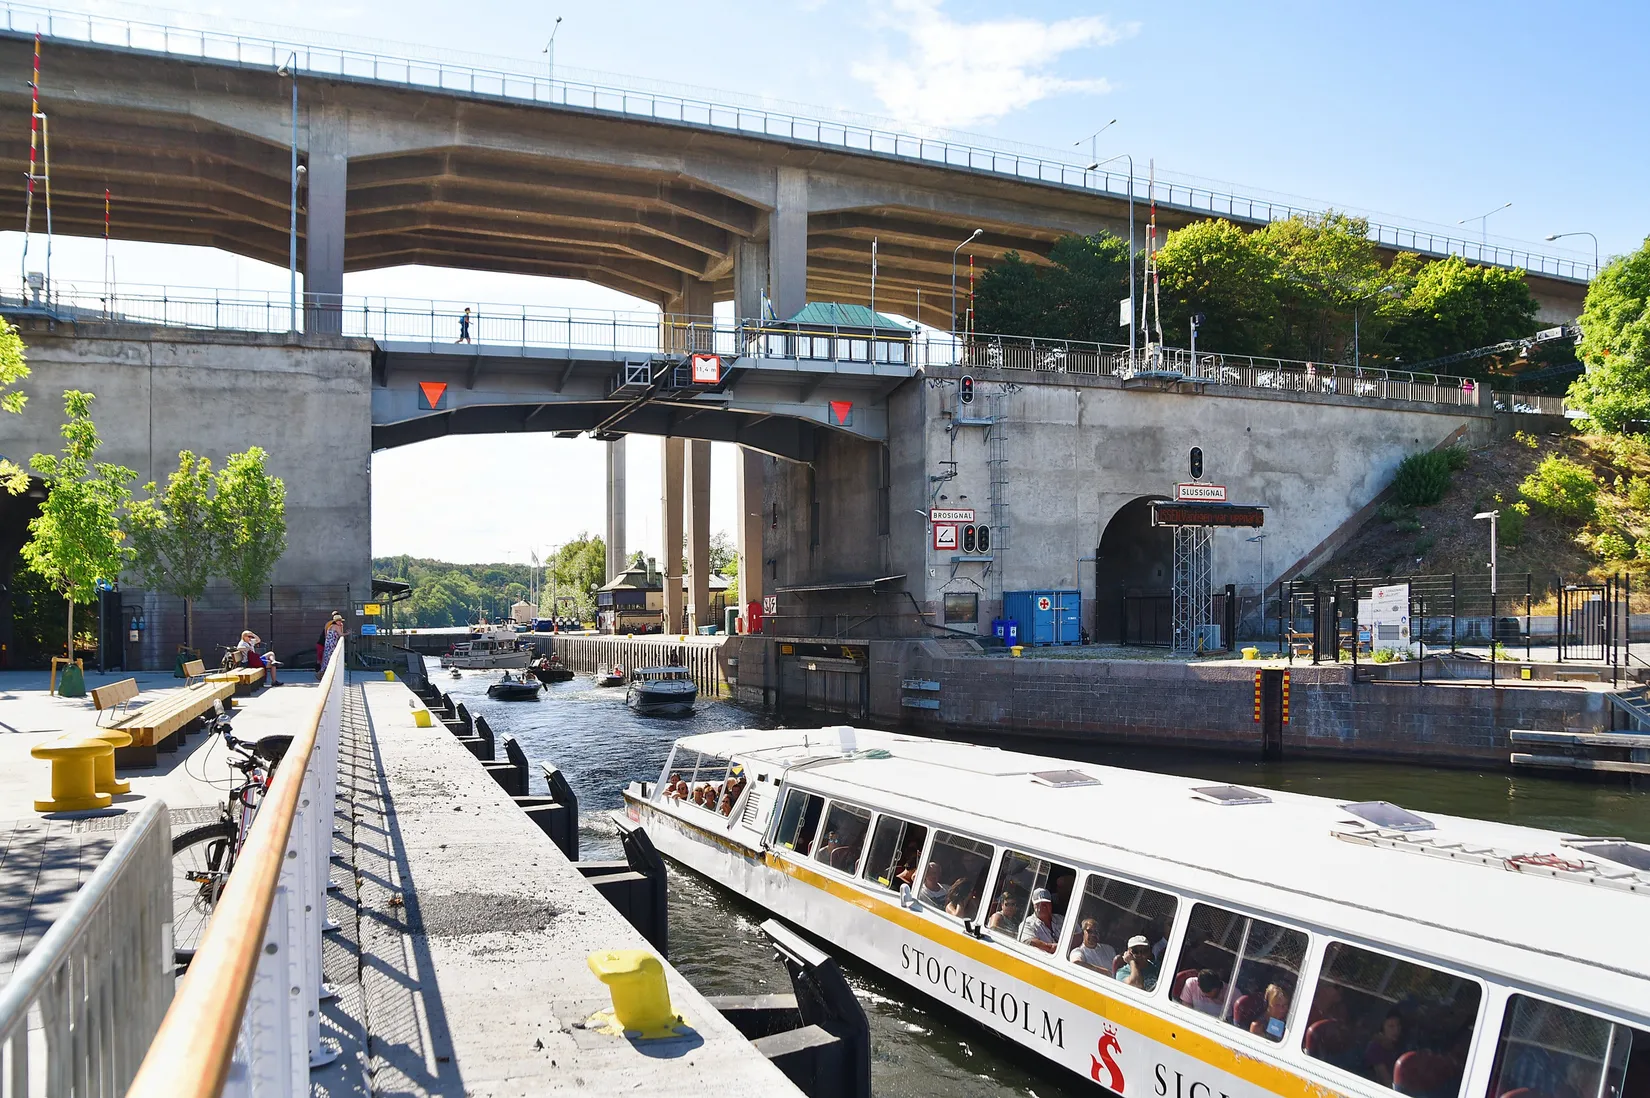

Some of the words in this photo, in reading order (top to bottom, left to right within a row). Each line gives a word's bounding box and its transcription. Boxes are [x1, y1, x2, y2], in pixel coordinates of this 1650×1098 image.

[1181, 488, 1224, 497] SLUSSIGNAL
[901, 943, 1066, 1051] STOCKHOLM
[1154, 1062, 1230, 1098] SI
